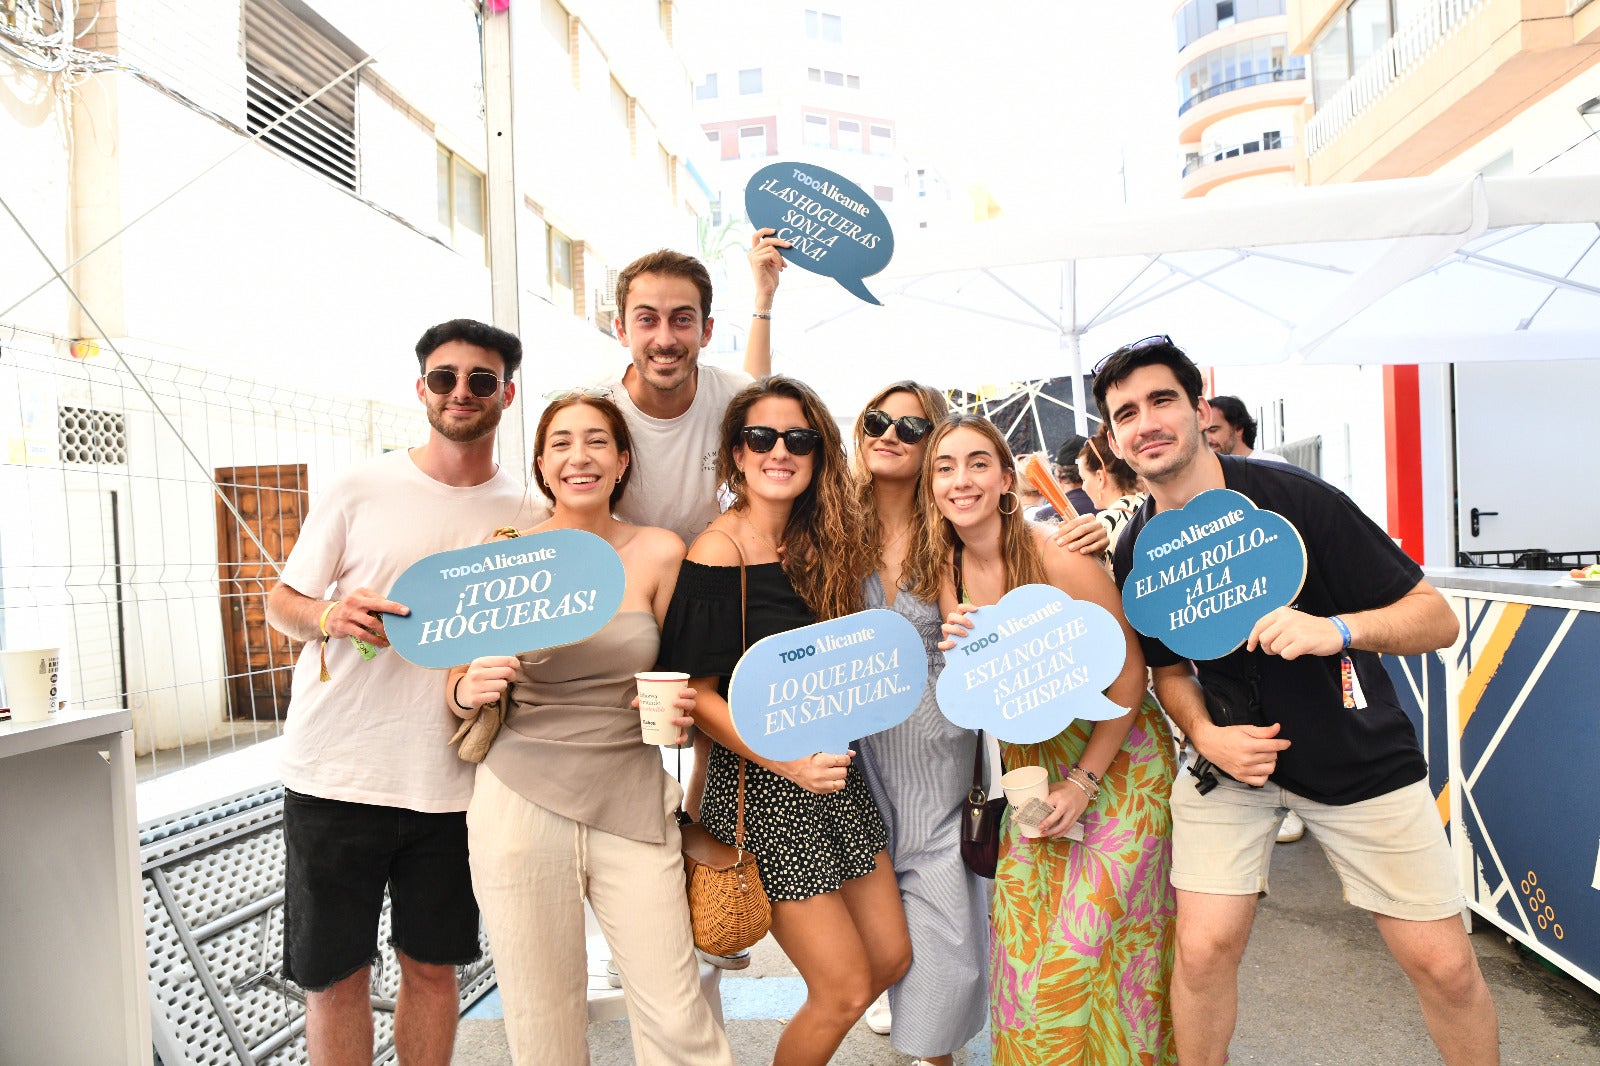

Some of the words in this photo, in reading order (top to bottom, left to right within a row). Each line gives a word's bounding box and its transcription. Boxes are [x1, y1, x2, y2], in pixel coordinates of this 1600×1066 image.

[758, 178, 799, 203] ¡LAS
[793, 195, 881, 249] HOGUERAS
[781, 209, 818, 235] SON
[810, 226, 840, 248] LA
[777, 227, 828, 262] CAÑA!
[455, 569, 553, 615] ¡TODO
[1135, 575, 1158, 600] EL
[1158, 556, 1200, 590] MAL
[1200, 527, 1278, 571] ROLLO...
[1186, 576, 1205, 606] ¡A
[1206, 565, 1233, 592] LA
[417, 589, 597, 646] HOGUERAS!
[1168, 576, 1268, 631] HOGUERA!
[767, 678, 799, 707] LO
[802, 662, 848, 701] QUE
[850, 647, 900, 683] PASA
[963, 652, 1014, 692] ESTA
[1015, 615, 1088, 667] NOCHE
[993, 646, 1076, 706] ¡SALTAN
[764, 705, 798, 737] EN
[800, 691, 843, 724] SAN
[843, 673, 911, 716] JUAN...
[1002, 664, 1090, 721] CHISPAS!
